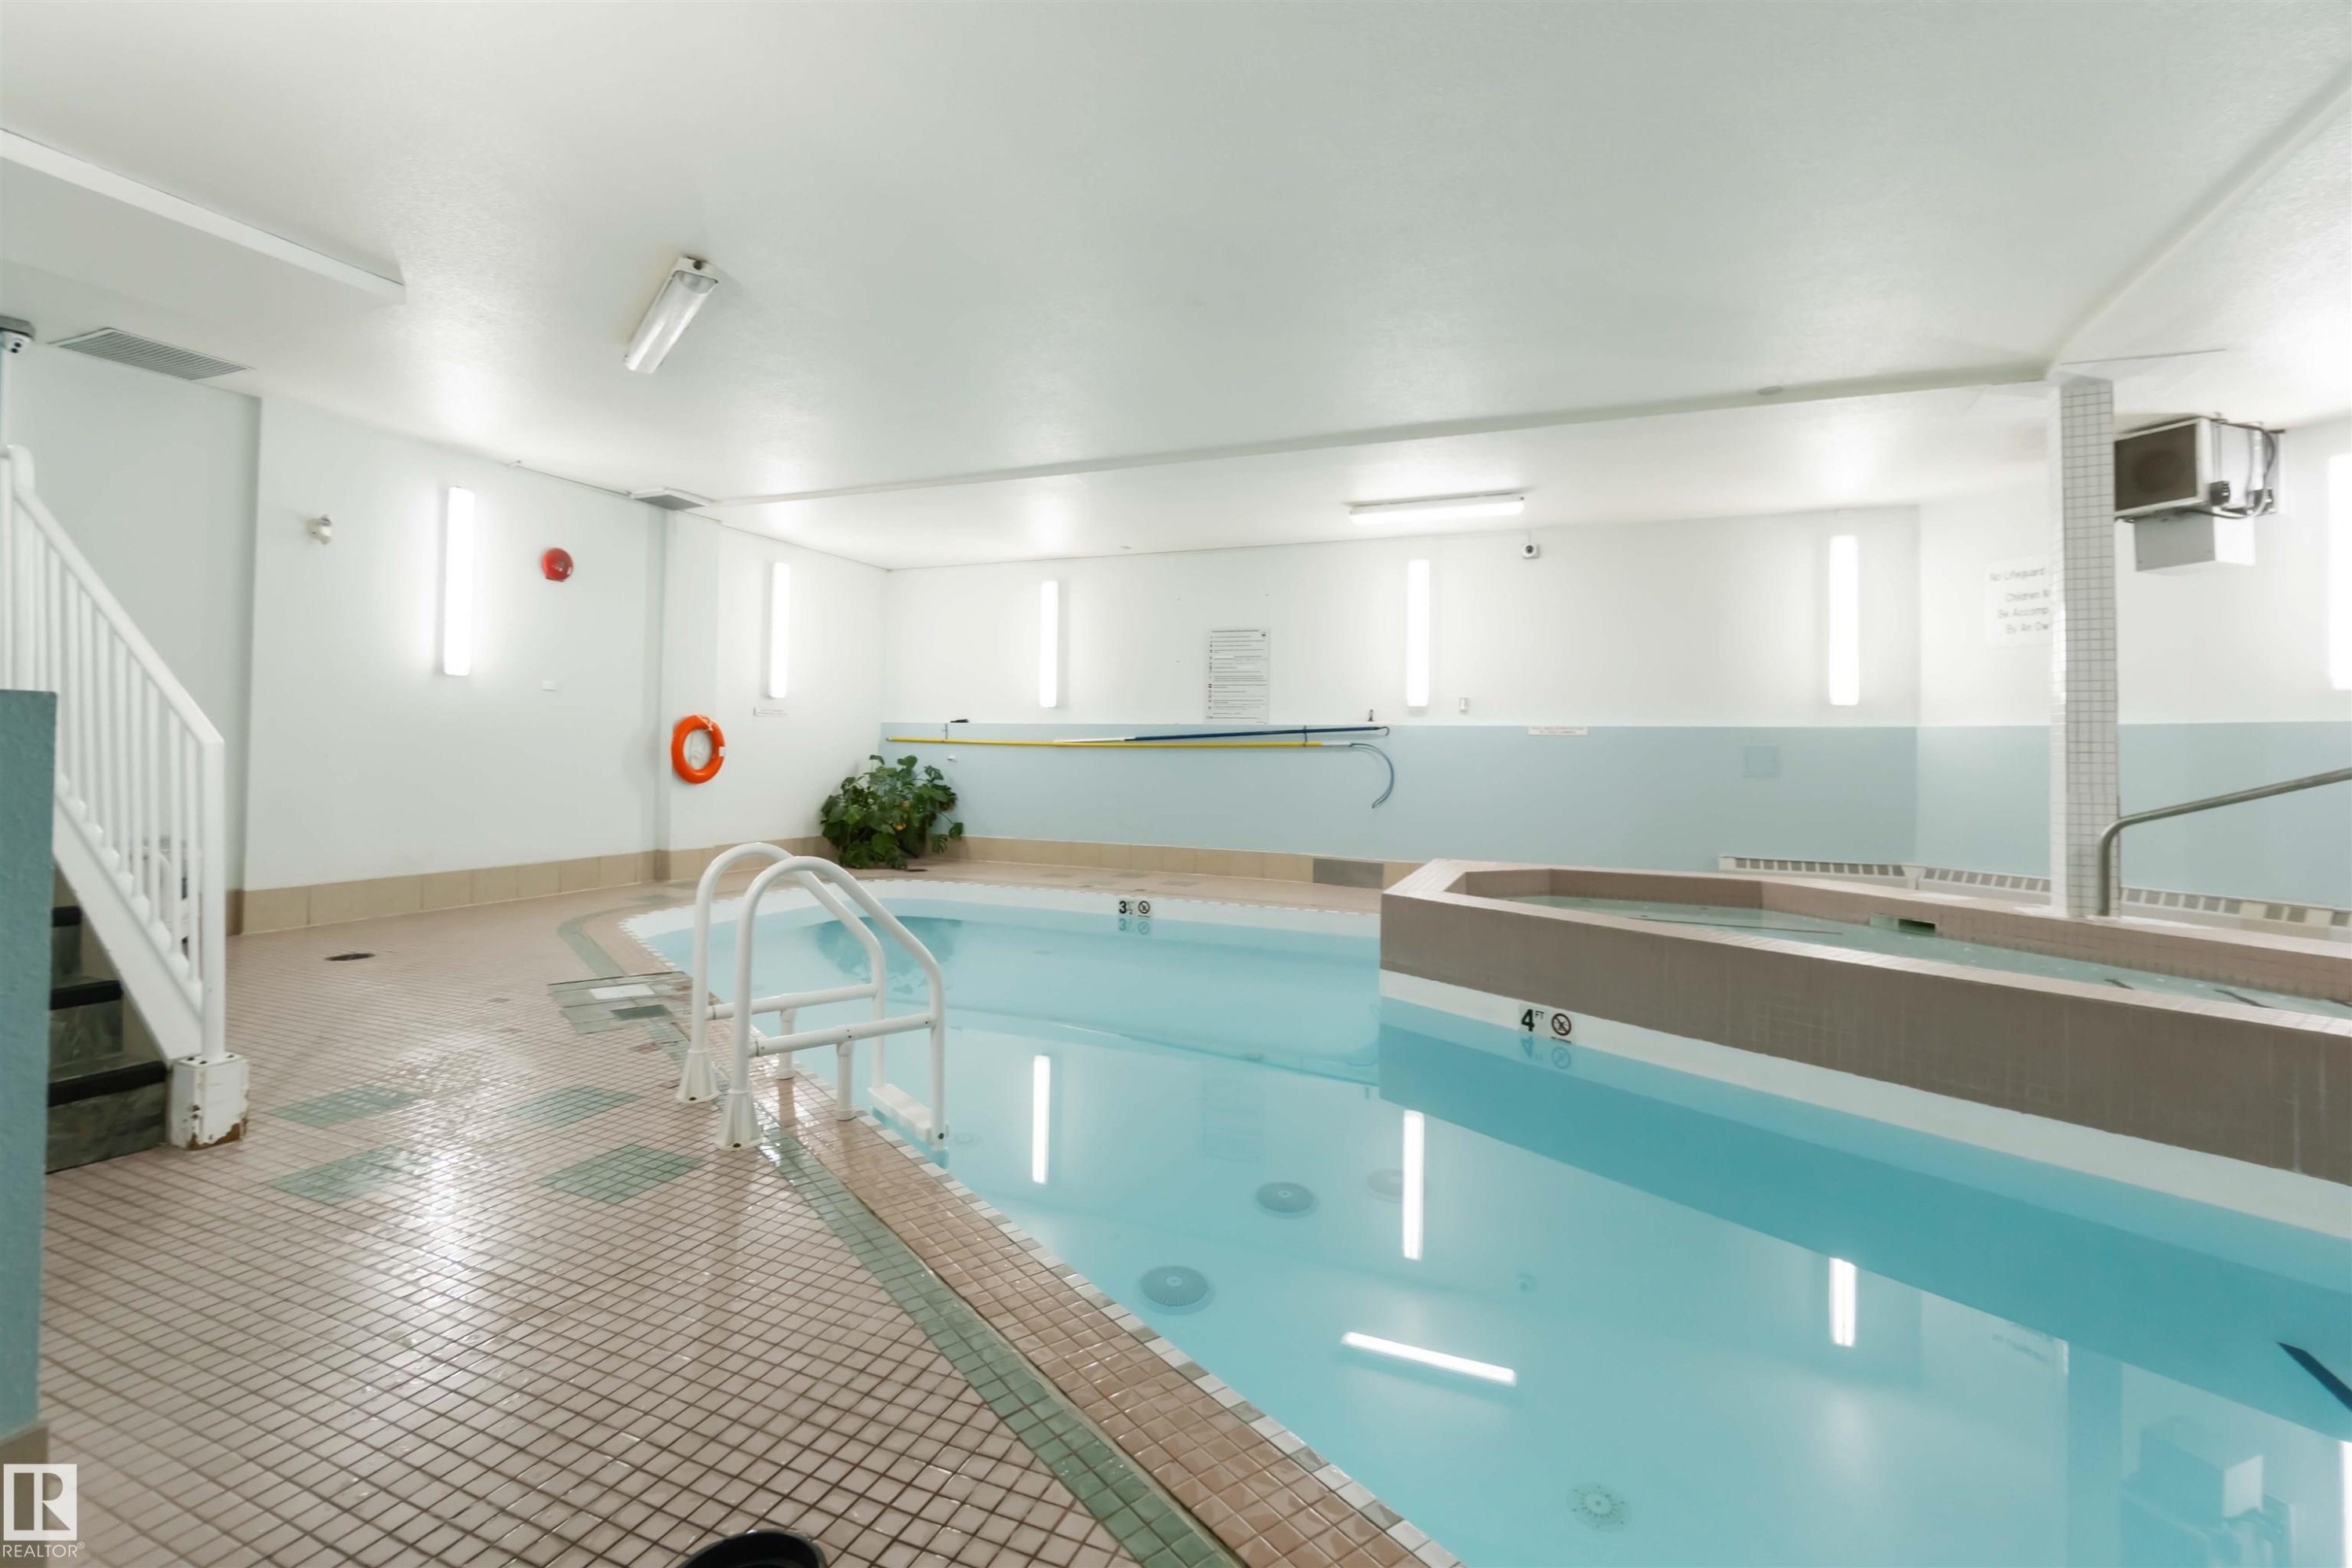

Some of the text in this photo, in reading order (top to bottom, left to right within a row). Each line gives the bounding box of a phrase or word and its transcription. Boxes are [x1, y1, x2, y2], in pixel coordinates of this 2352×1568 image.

[2013, 606, 2049, 616] Accomp
[1119, 900, 1127, 914] 3
[1521, 1008, 1535, 1032] 4
